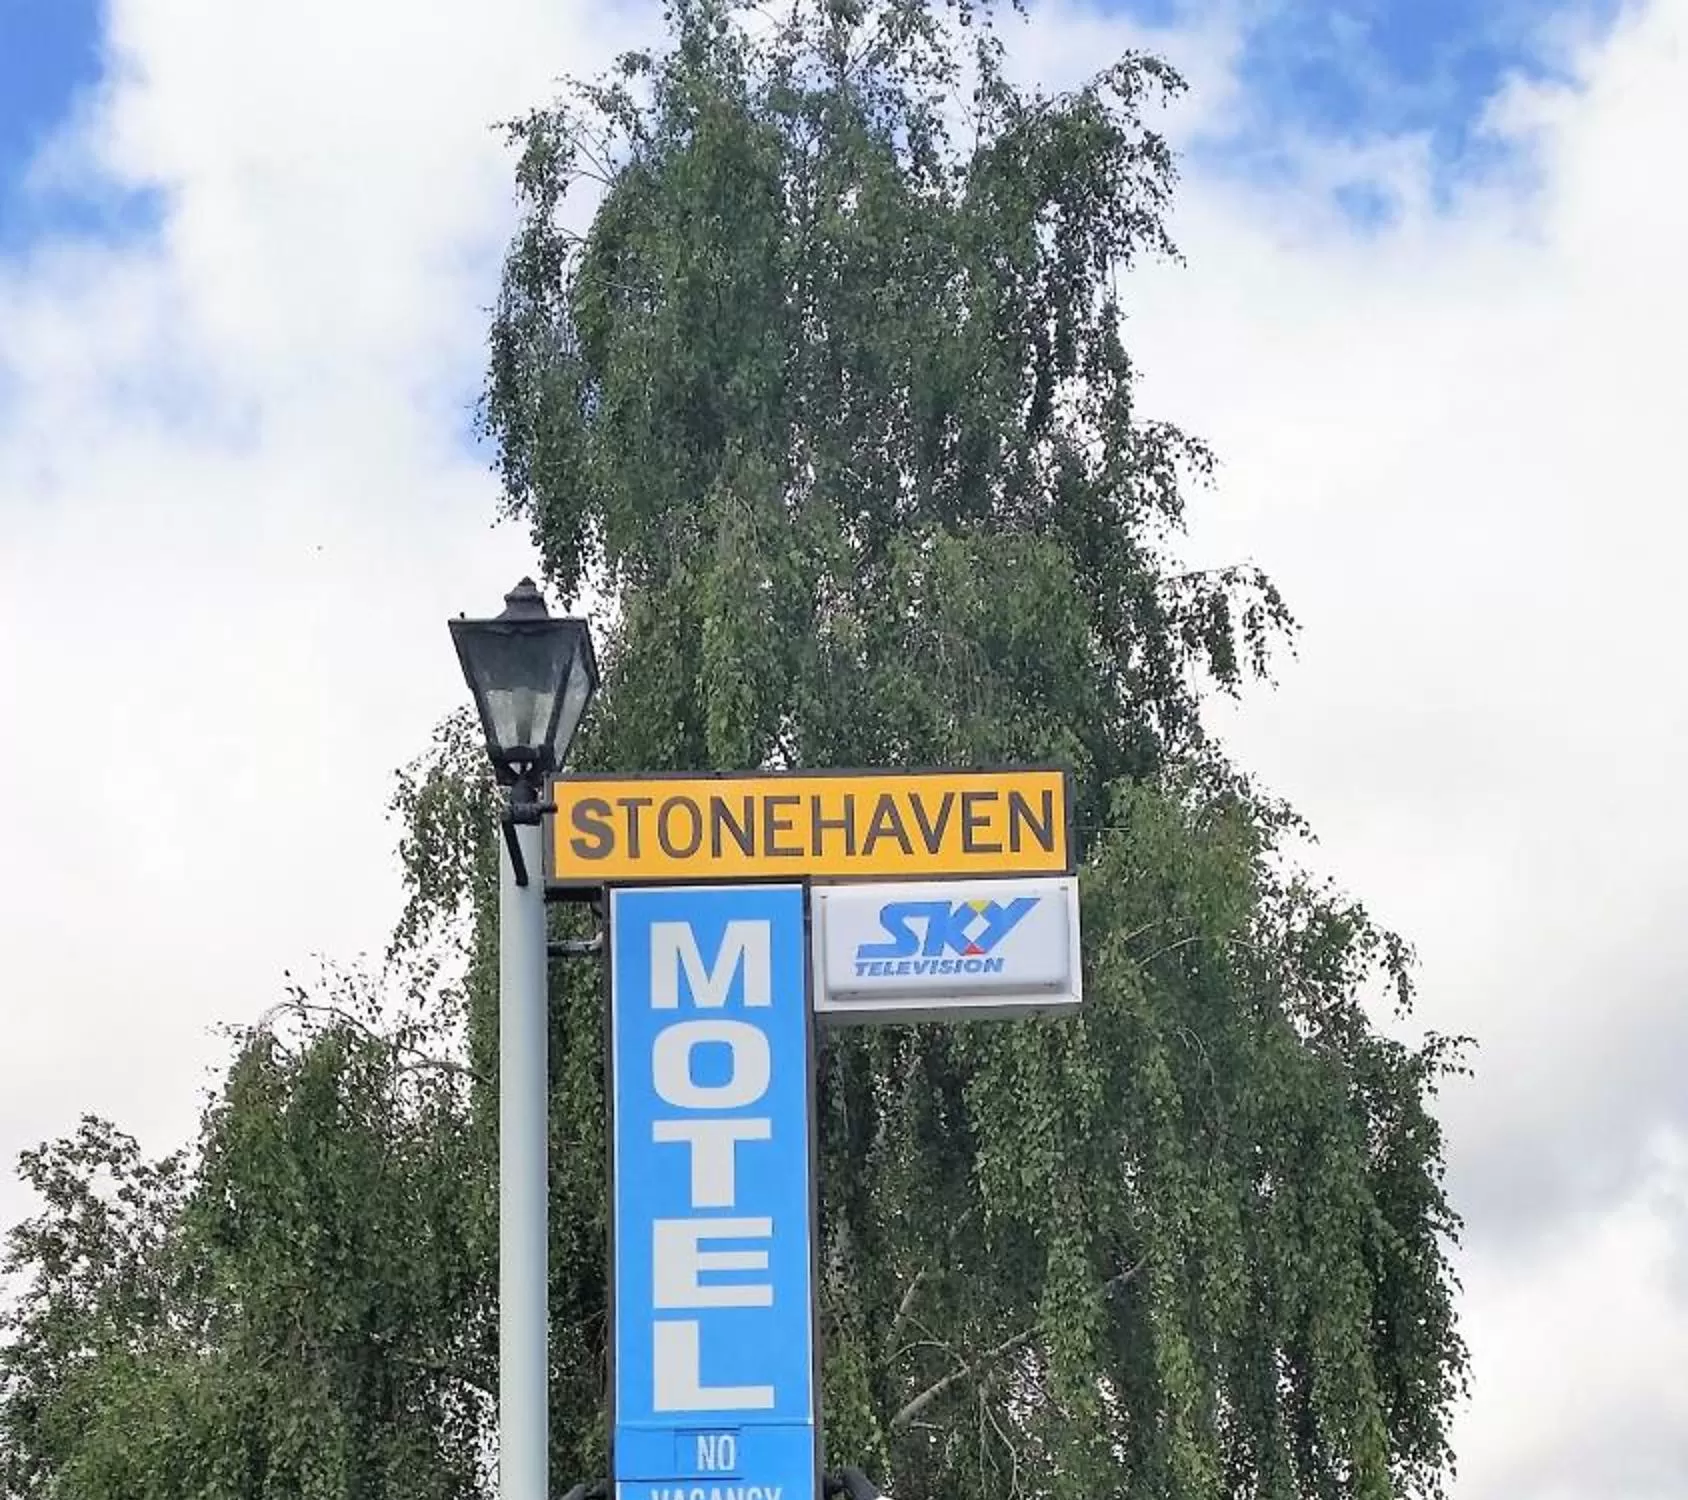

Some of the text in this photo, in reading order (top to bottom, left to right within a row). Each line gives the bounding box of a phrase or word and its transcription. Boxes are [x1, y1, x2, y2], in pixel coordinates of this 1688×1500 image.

[570, 788, 1054, 860] STONEHAVEN
[857, 897, 1040, 957] SKY
[854, 957, 1005, 977] TELEVISION
[650, 919, 775, 1412] MOTEL
[696, 1434, 736, 1472] NO
